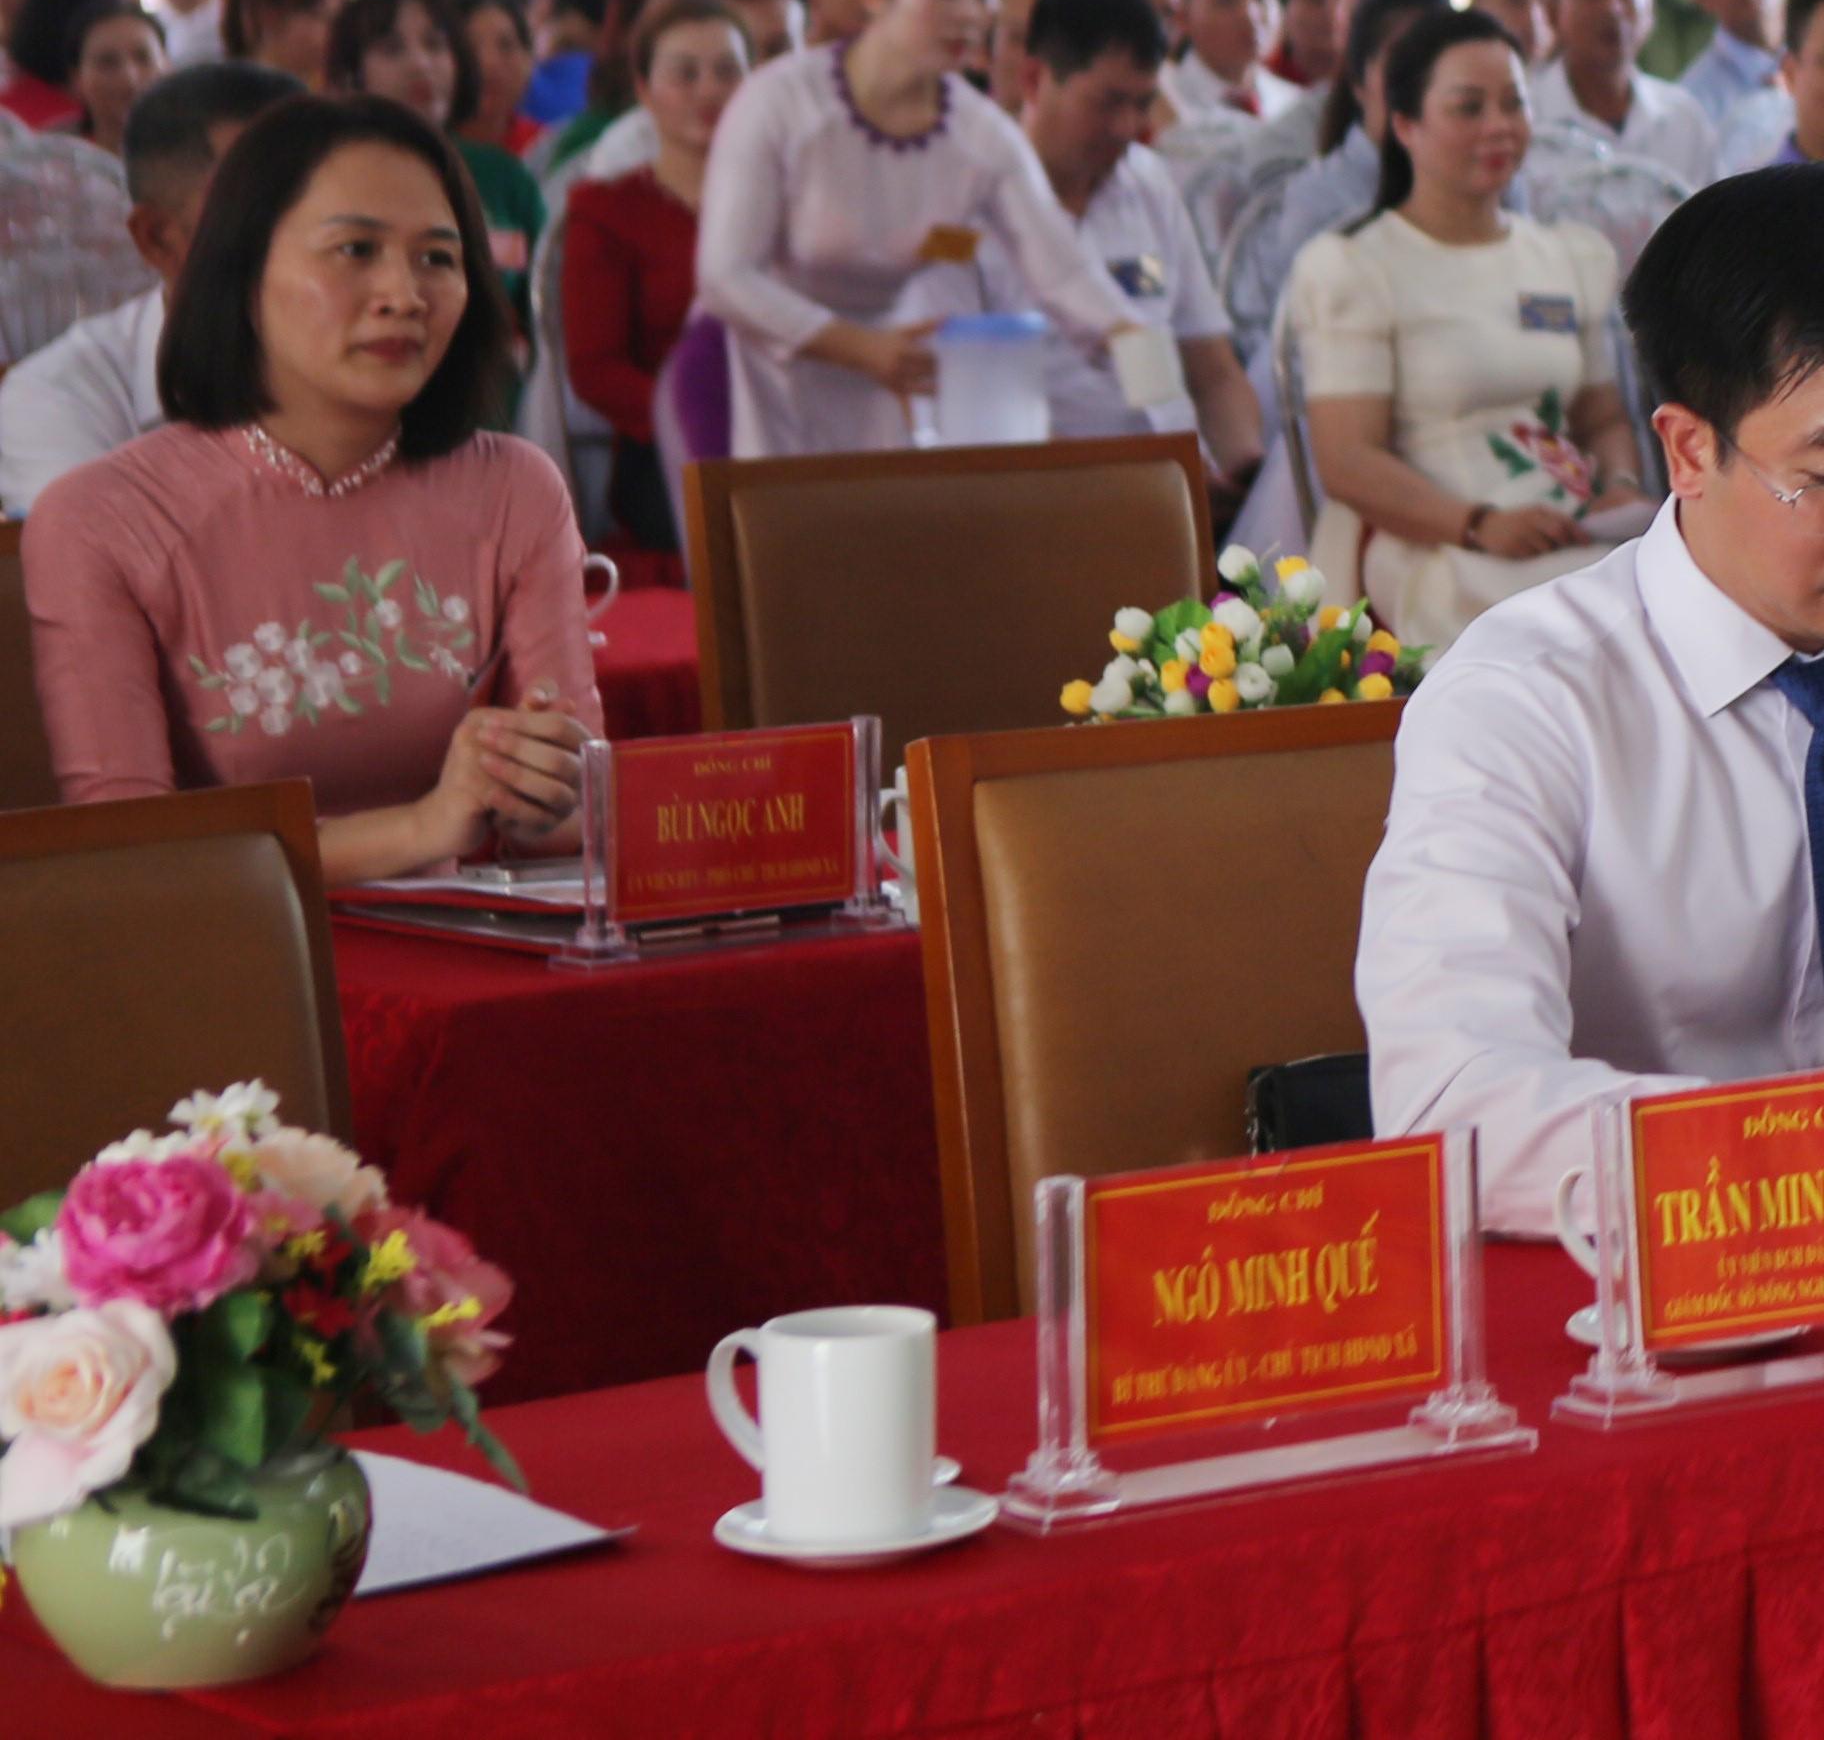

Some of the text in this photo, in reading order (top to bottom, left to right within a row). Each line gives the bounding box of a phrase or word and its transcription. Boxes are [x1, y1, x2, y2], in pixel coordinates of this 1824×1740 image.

[763, 792, 805, 835] ANH
[1743, 1105, 1809, 1140] ĐỒNG
[1655, 1156, 1751, 1247] TRẦN
[1152, 1209, 1381, 1328] NGÔ MINH QUẾ
